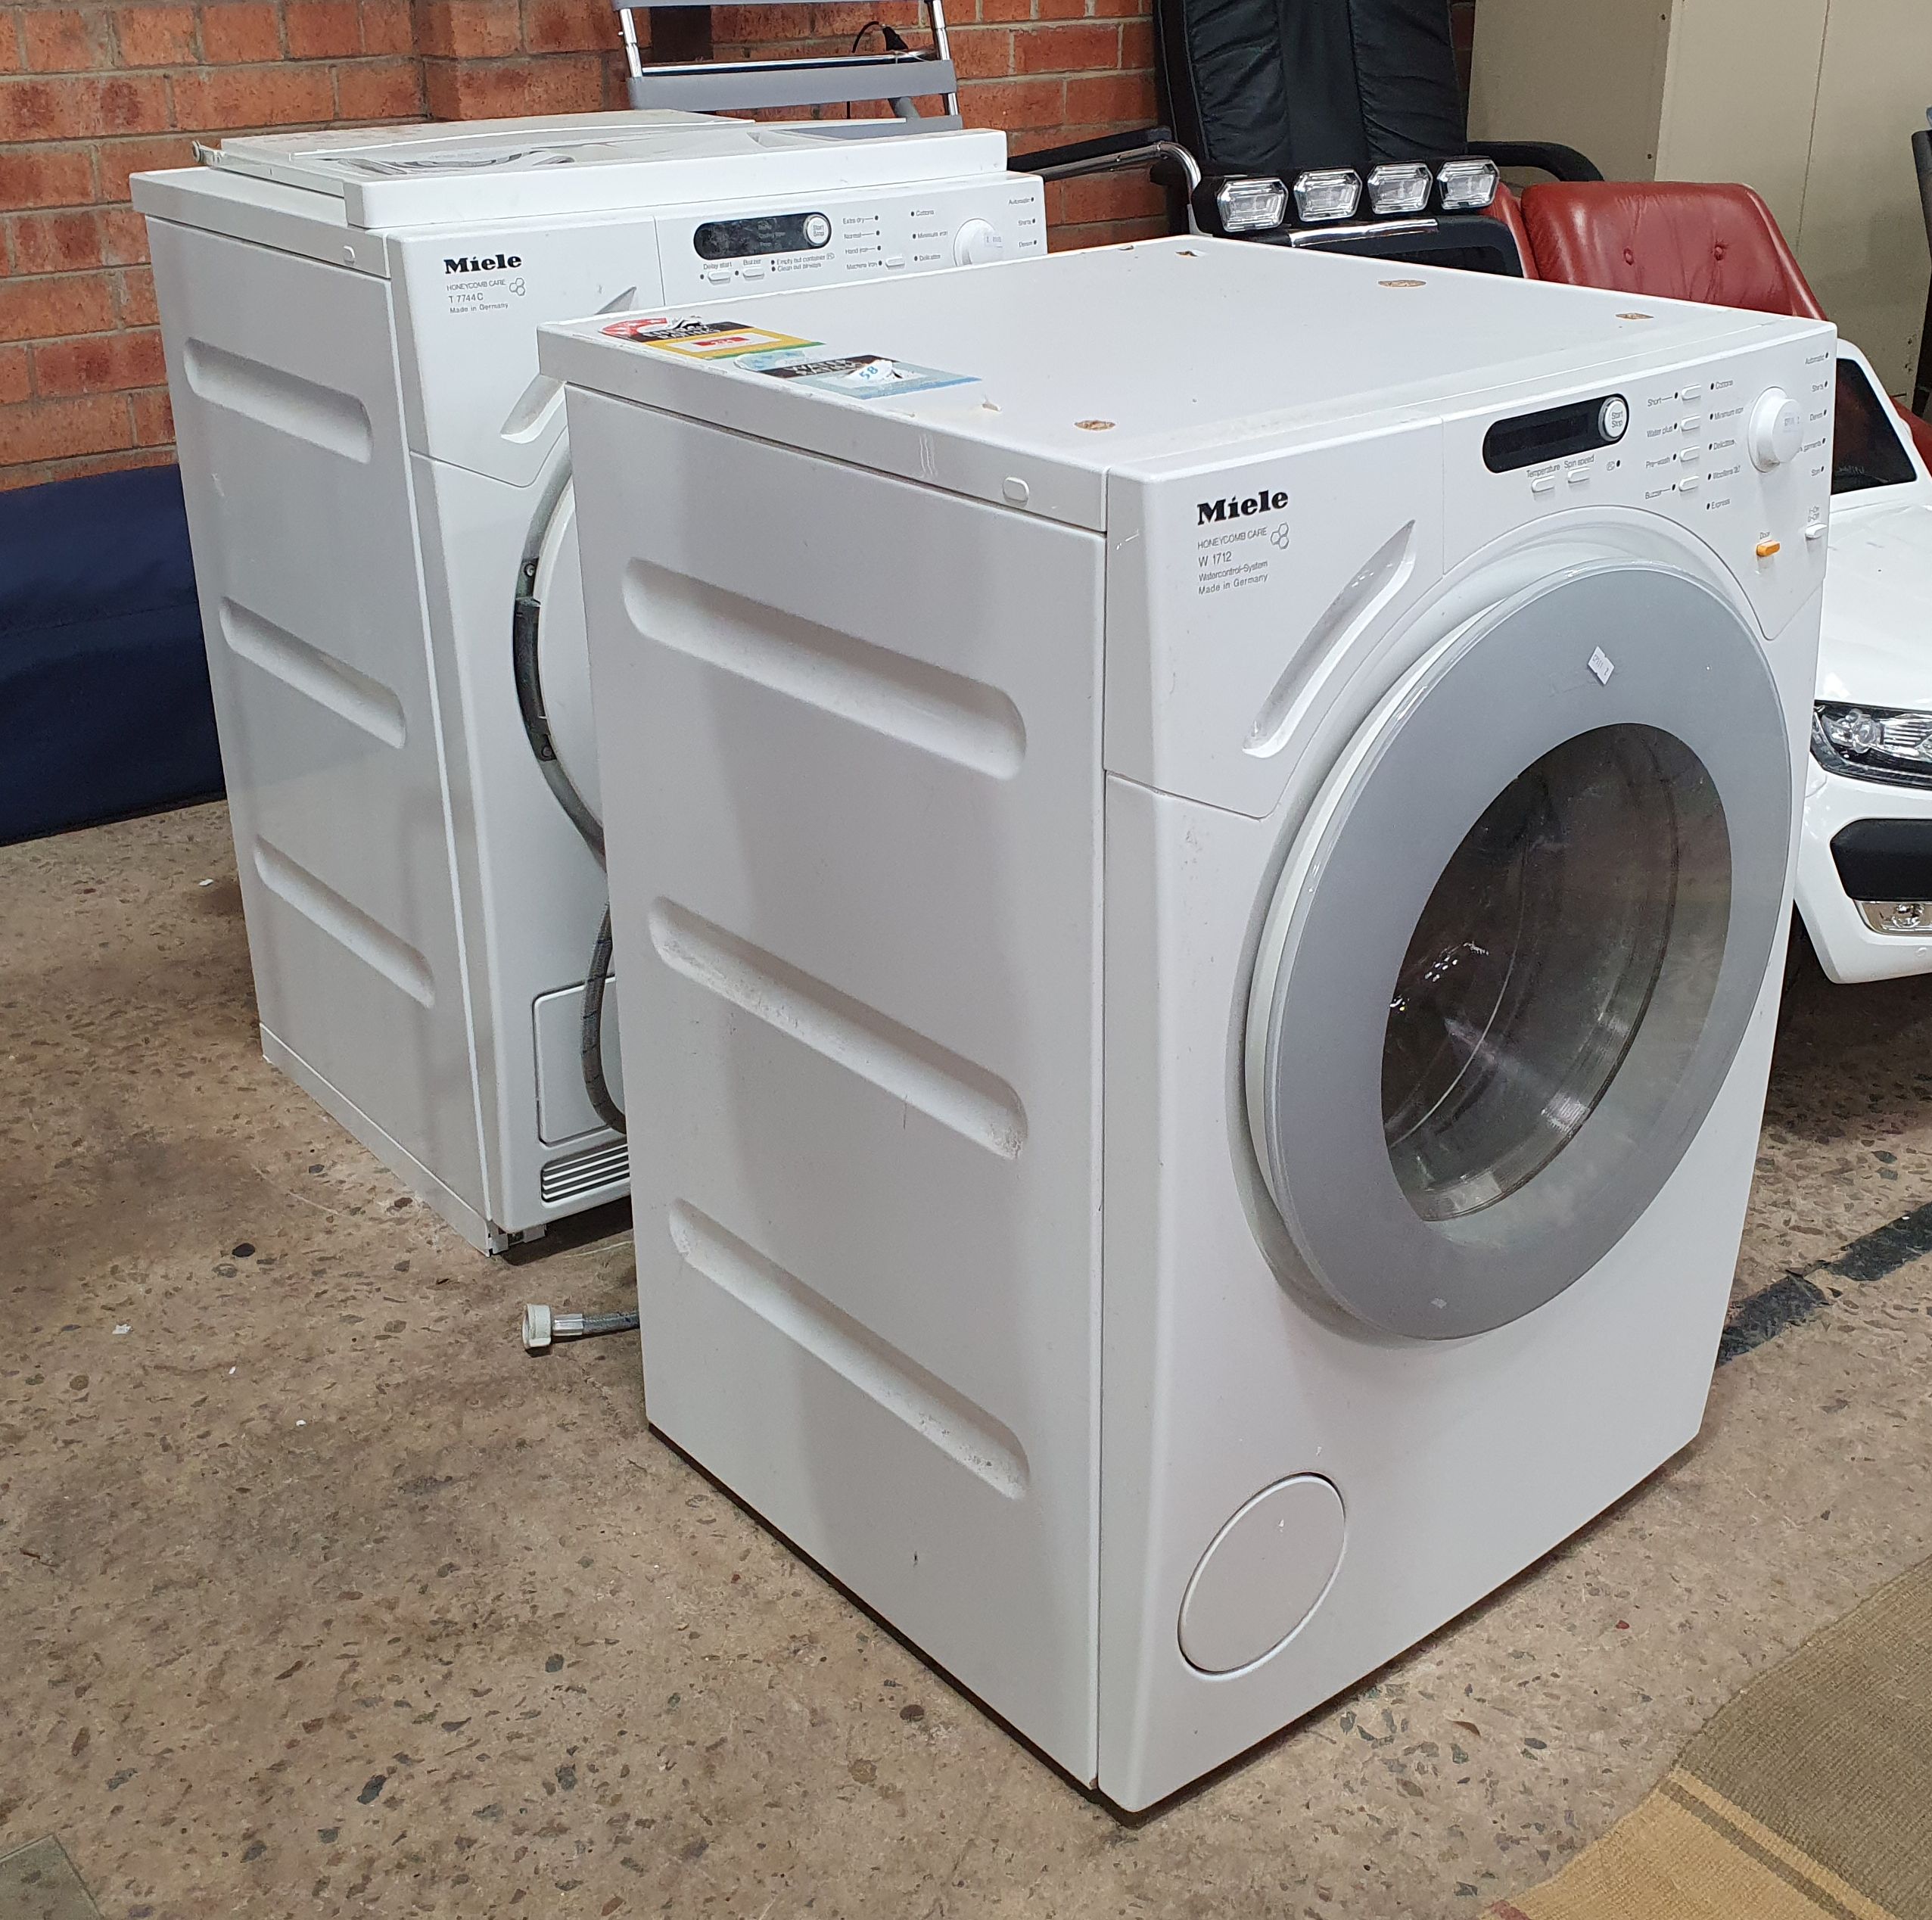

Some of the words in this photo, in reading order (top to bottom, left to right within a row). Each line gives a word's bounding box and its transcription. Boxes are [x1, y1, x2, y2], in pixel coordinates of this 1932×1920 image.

[443, 254, 522, 275] Miele
[446, 281, 488, 291] HONEYCOMB
[489, 279, 506, 287] CARE
[448, 295, 453, 303] T
[479, 303, 509, 311] Germany
[859, 366, 879, 379] 58
[1647, 397, 1662, 407] Short
[1611, 411, 1623, 419] Start
[1611, 420, 1622, 428] Stop
[1647, 428, 1661, 437] Water
[1662, 425, 1672, 434] plus
[1526, 464, 1560, 478] Temperature
[1563, 460, 1577, 469] Spin
[1578, 454, 1594, 465] speed
[1646, 456, 1670, 468] Pre-wash
[1197, 490, 1289, 526] Miele
[1712, 499, 1730, 509] Express
[1198, 531, 1246, 550] HONEYCOMB
[1247, 526, 1268, 540] CARE
[1198, 555, 1209, 568] W
[1212, 551, 1232, 565] 1712
[1199, 561, 1268, 582] Watercontrol-System
[1198, 583, 1221, 596] Made
[1223, 581, 1230, 590] in
[1233, 574, 1268, 588] Germany
